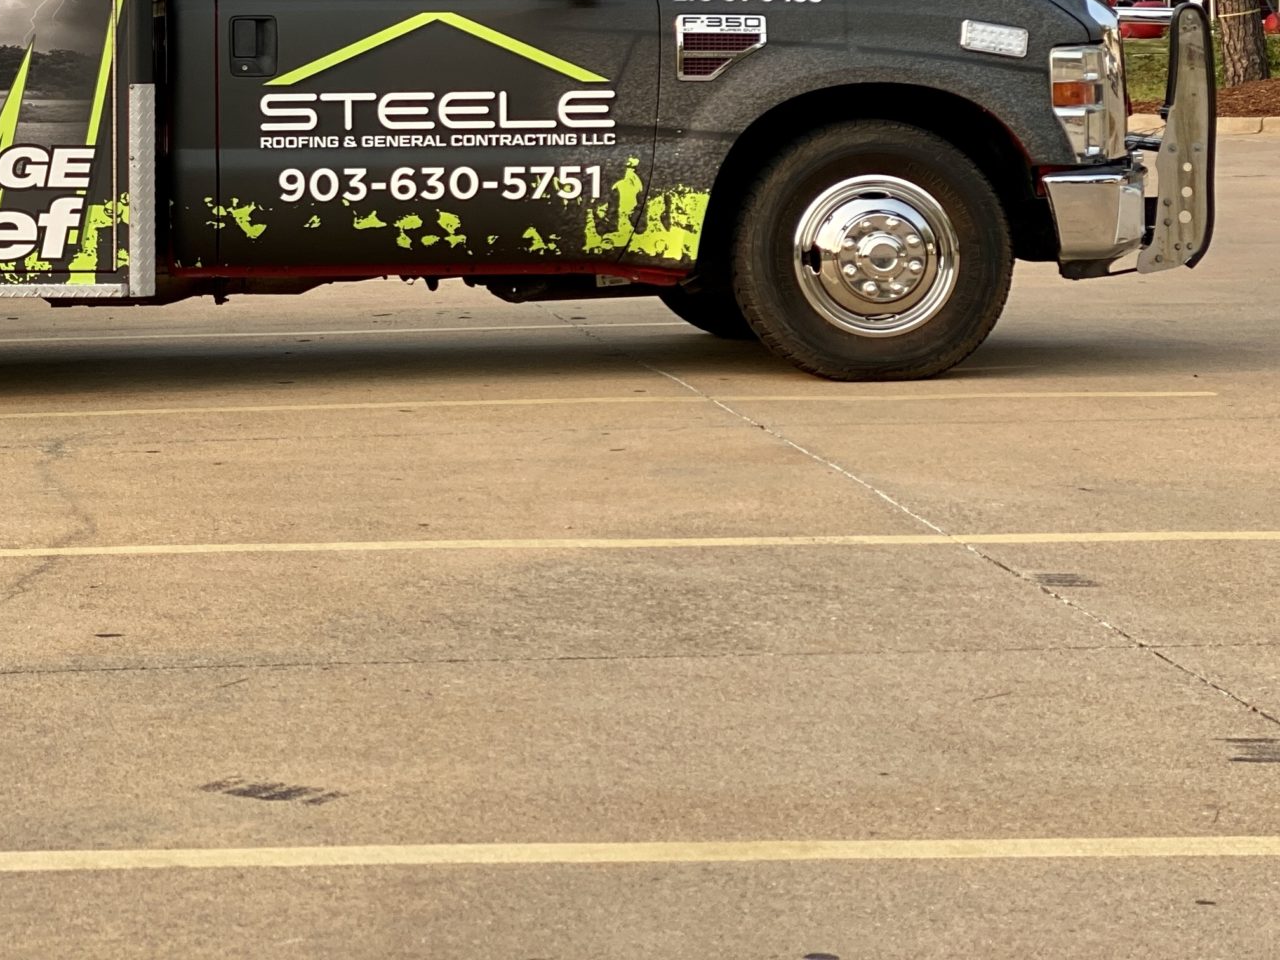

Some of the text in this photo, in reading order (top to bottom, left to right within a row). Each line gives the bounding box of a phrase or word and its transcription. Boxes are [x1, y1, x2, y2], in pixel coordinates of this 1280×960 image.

[260, 90, 616, 131] STEELE
[260, 133, 616, 149] ROOFING & GENERAL CONTRACTING LLC
[278, 165, 602, 202] 903-630-5751
